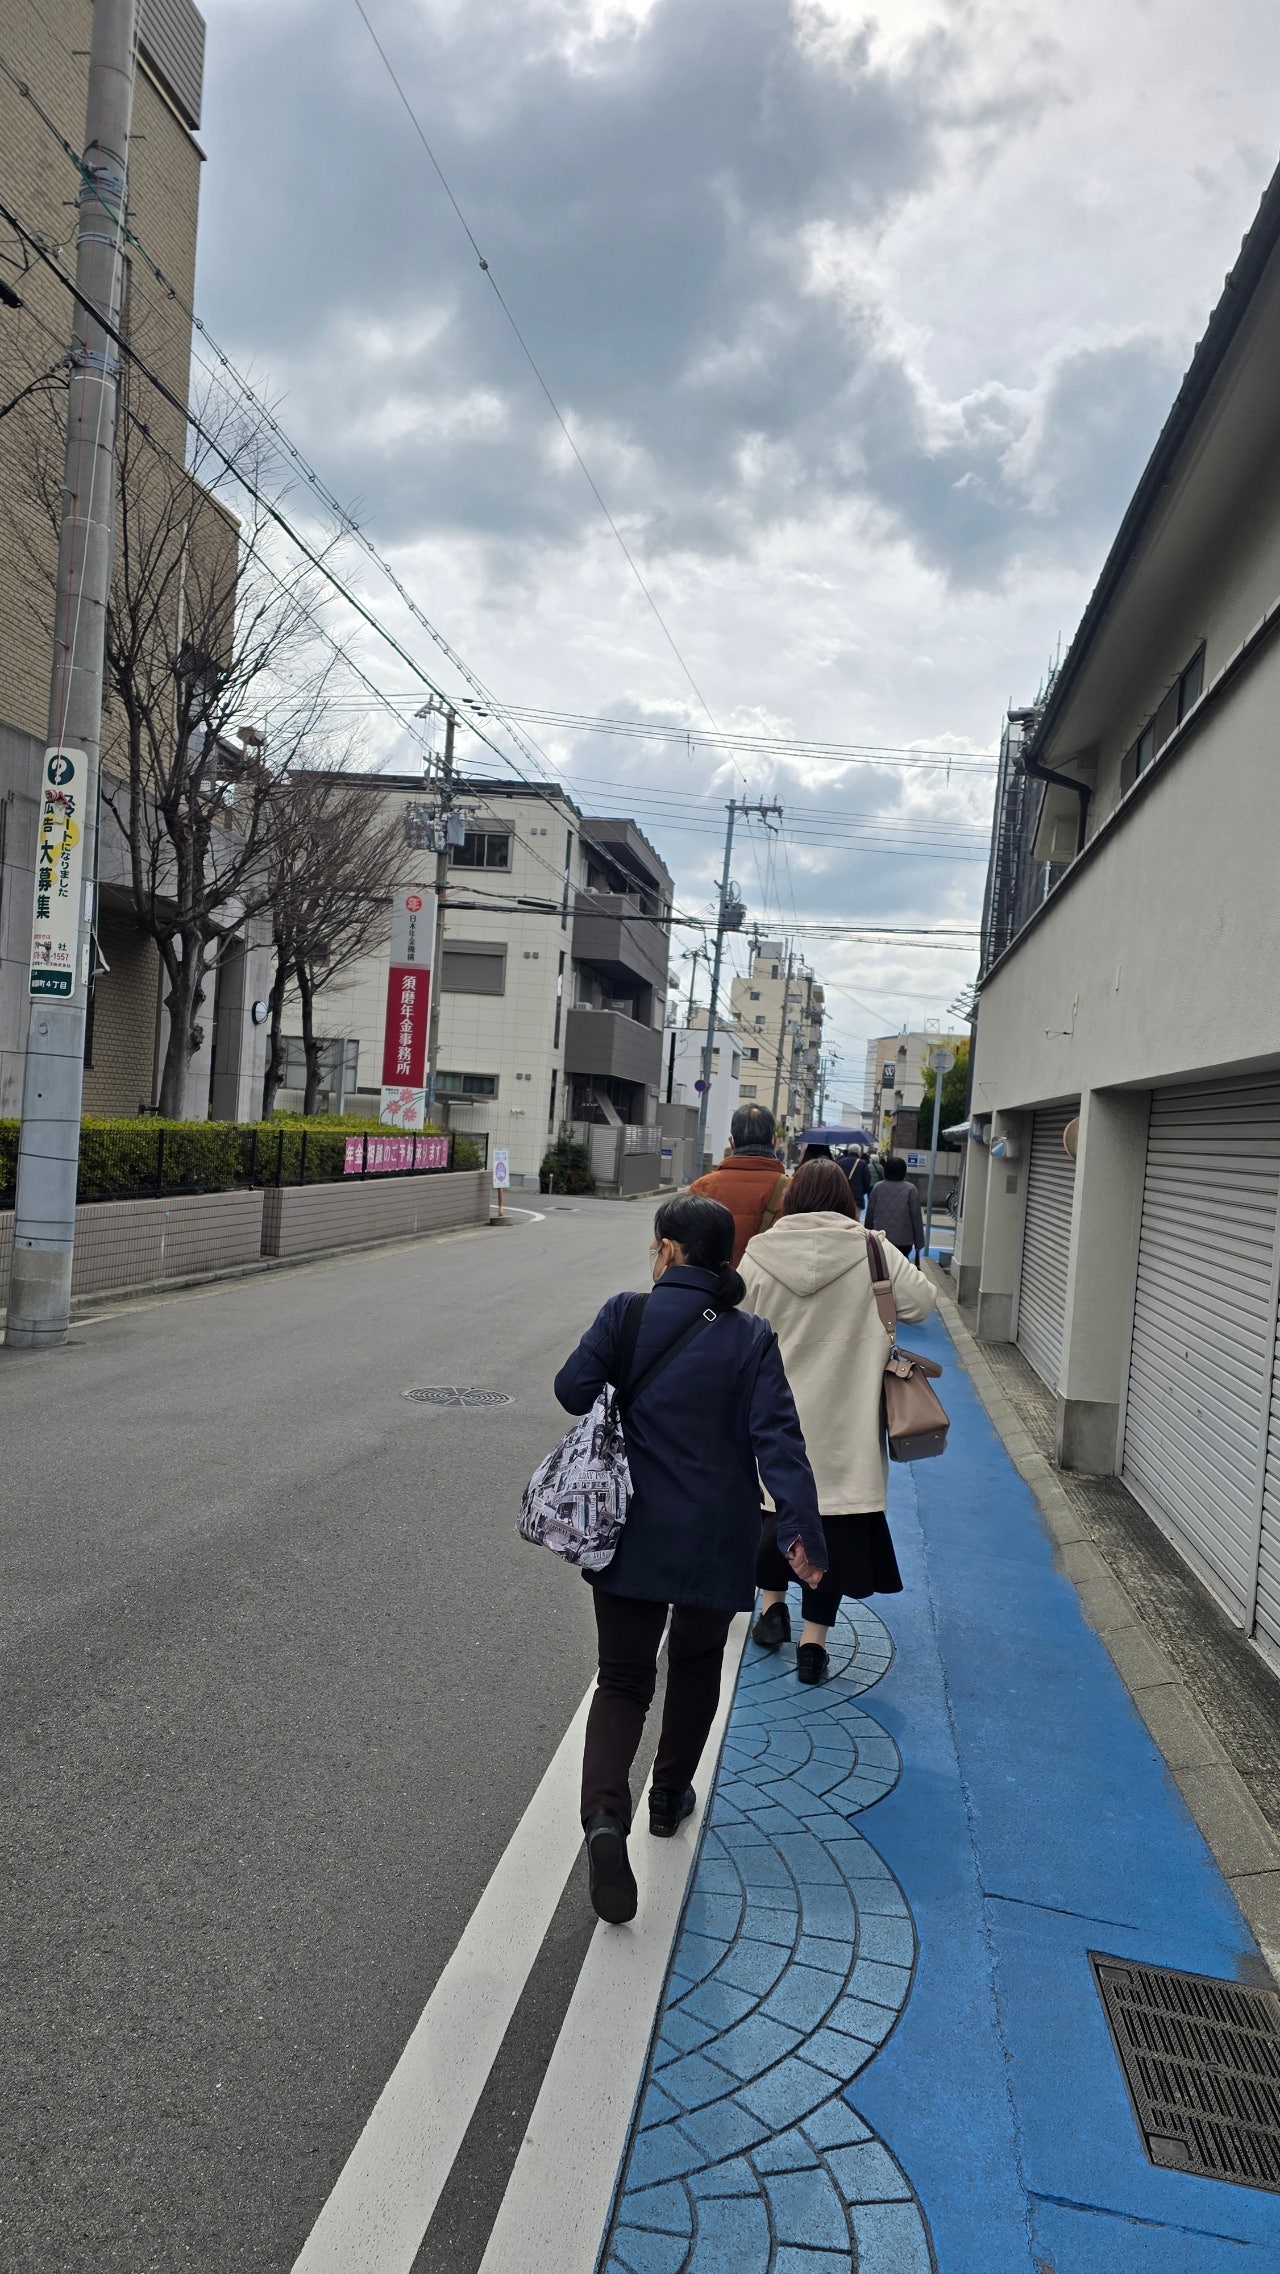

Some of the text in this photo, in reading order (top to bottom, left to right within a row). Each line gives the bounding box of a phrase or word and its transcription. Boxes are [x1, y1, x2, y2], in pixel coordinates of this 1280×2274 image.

[407, 915, 417, 961] 日本年金機構
[396, 975, 417, 1076] 須磨年金事務所
[345, 1143, 442, 1165] 年金相談のご予約承ります
